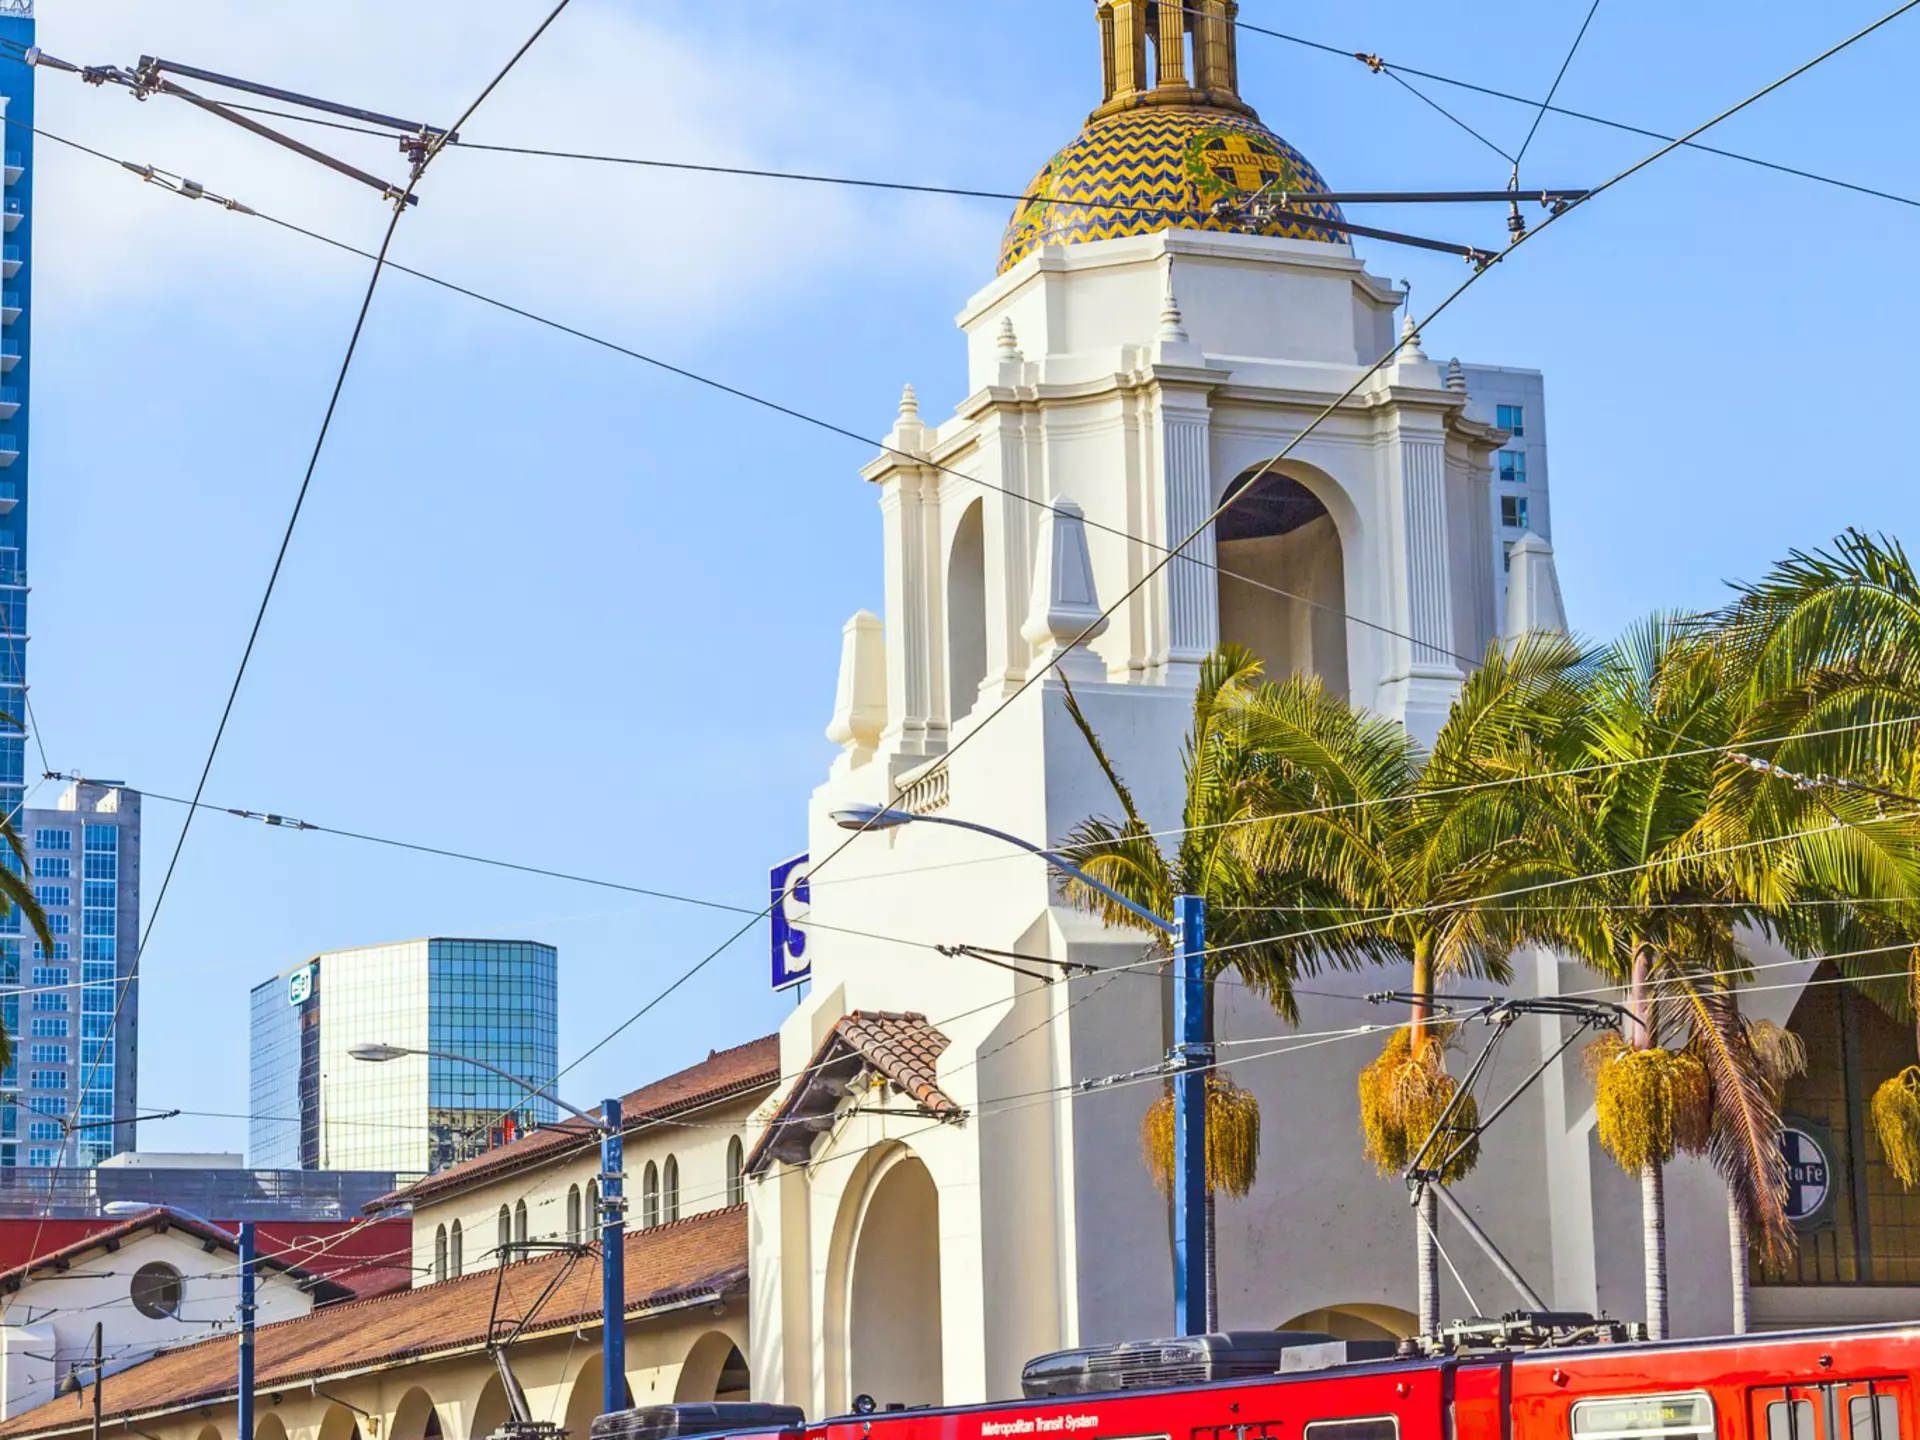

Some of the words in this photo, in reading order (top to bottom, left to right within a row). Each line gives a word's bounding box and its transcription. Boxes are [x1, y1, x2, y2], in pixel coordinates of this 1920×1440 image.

[1205, 151, 1260, 166] Santa
[1806, 1164, 1823, 1184] Fe
[981, 1419, 1034, 1437] Metropolitan
[1035, 1416, 1064, 1432] Transit
[1065, 1414, 1099, 1432] System
